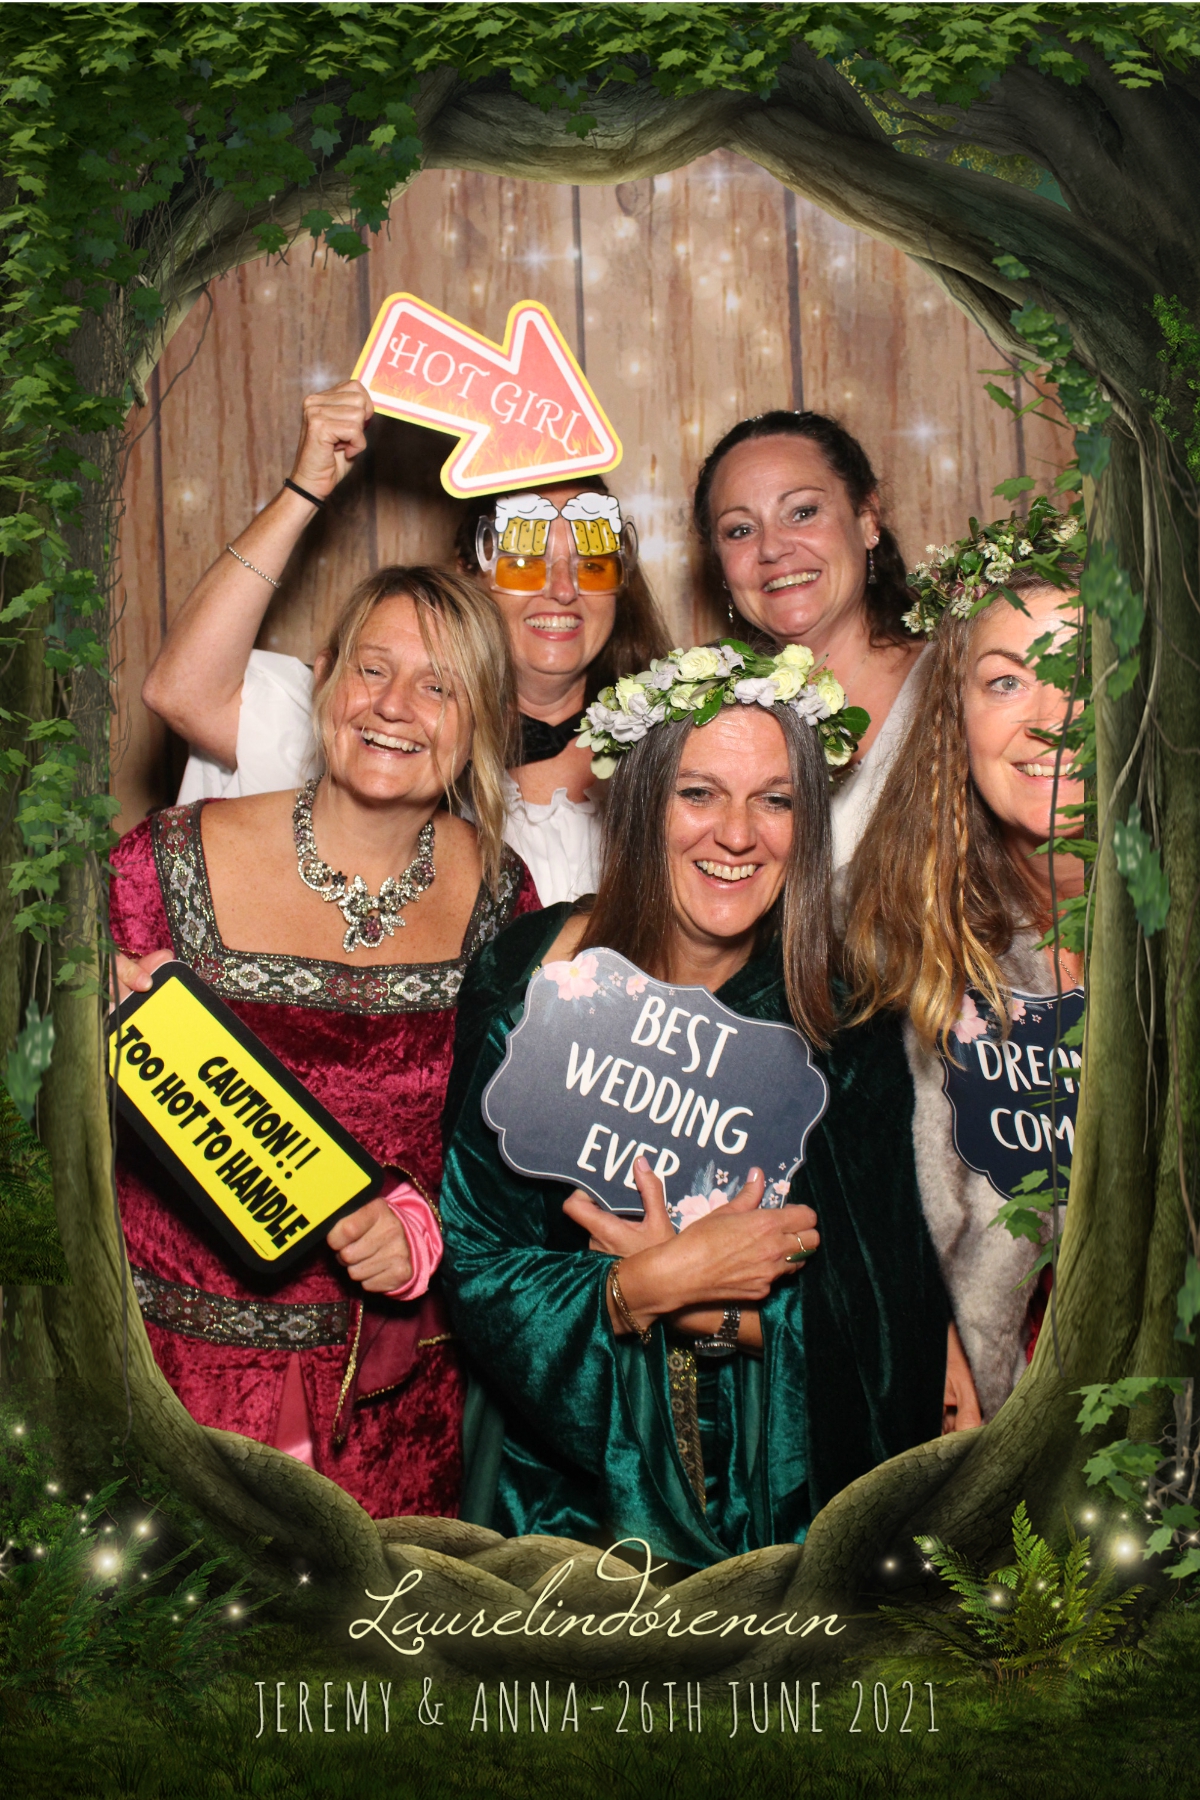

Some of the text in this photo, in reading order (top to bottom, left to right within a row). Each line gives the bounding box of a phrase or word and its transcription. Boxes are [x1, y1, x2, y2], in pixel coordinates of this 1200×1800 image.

[388, 332, 582, 456] HOT GIRL
[631, 996, 738, 1078] BEST
[115, 1024, 311, 1250] TOO HOT TO HANDLE
[198, 1056, 321, 1179] CAUTION!!
[565, 1041, 754, 1155] WEDDING
[576, 1123, 680, 1190] EVER
